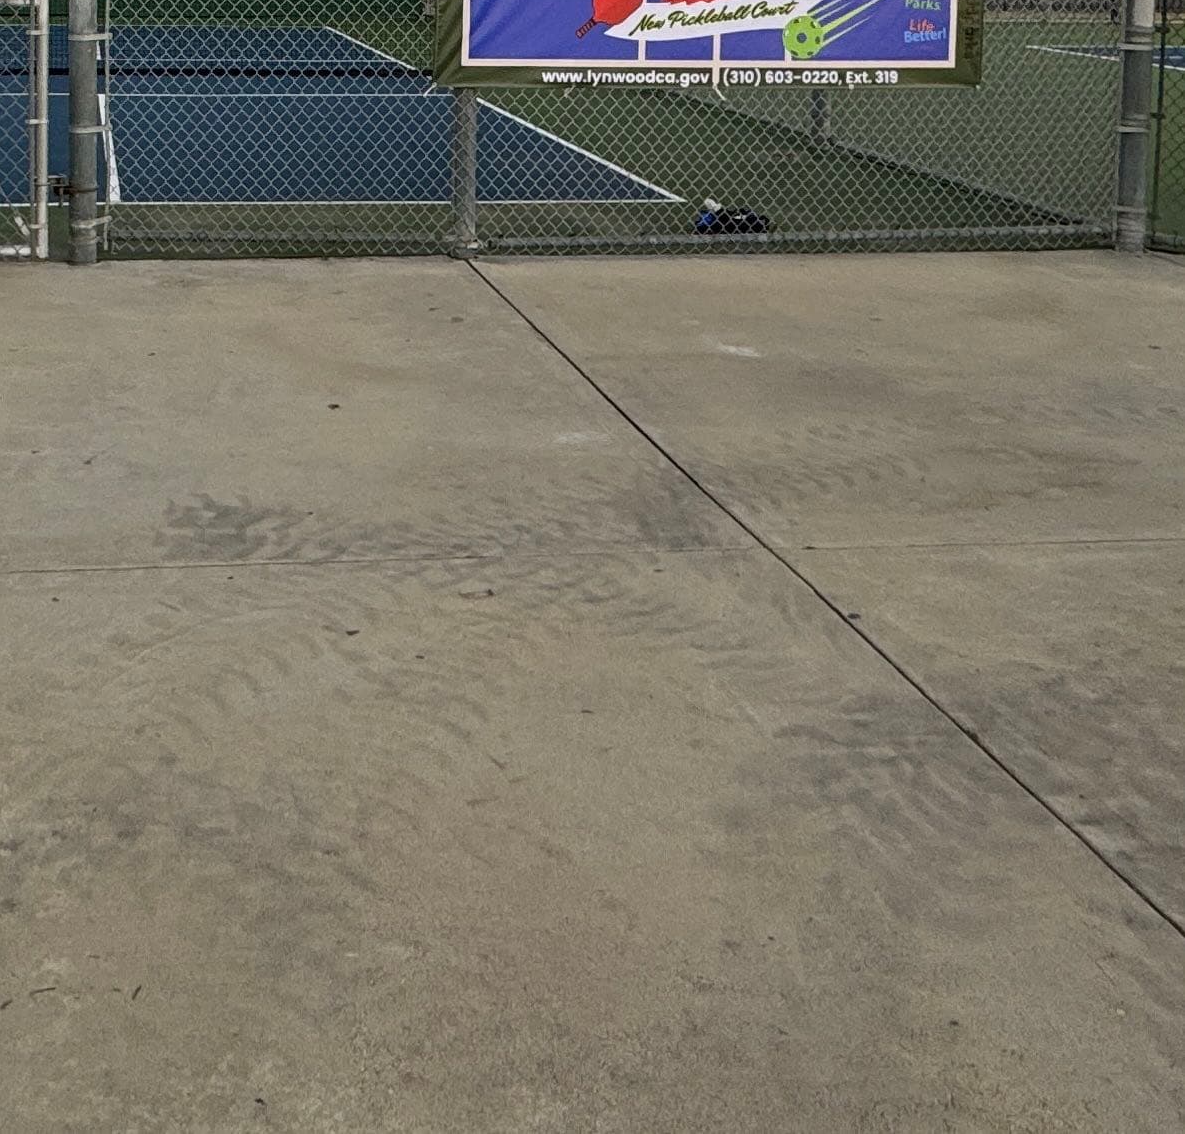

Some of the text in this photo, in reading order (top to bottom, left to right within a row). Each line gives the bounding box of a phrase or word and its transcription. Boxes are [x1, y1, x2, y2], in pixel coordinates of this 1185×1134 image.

[628, 0, 799, 36] New Pickleball Court
[909, 18, 936, 31] Life
[541, 69, 899, 87] www.lynwoodca.gov (310) 603-0220, Ext. 319
